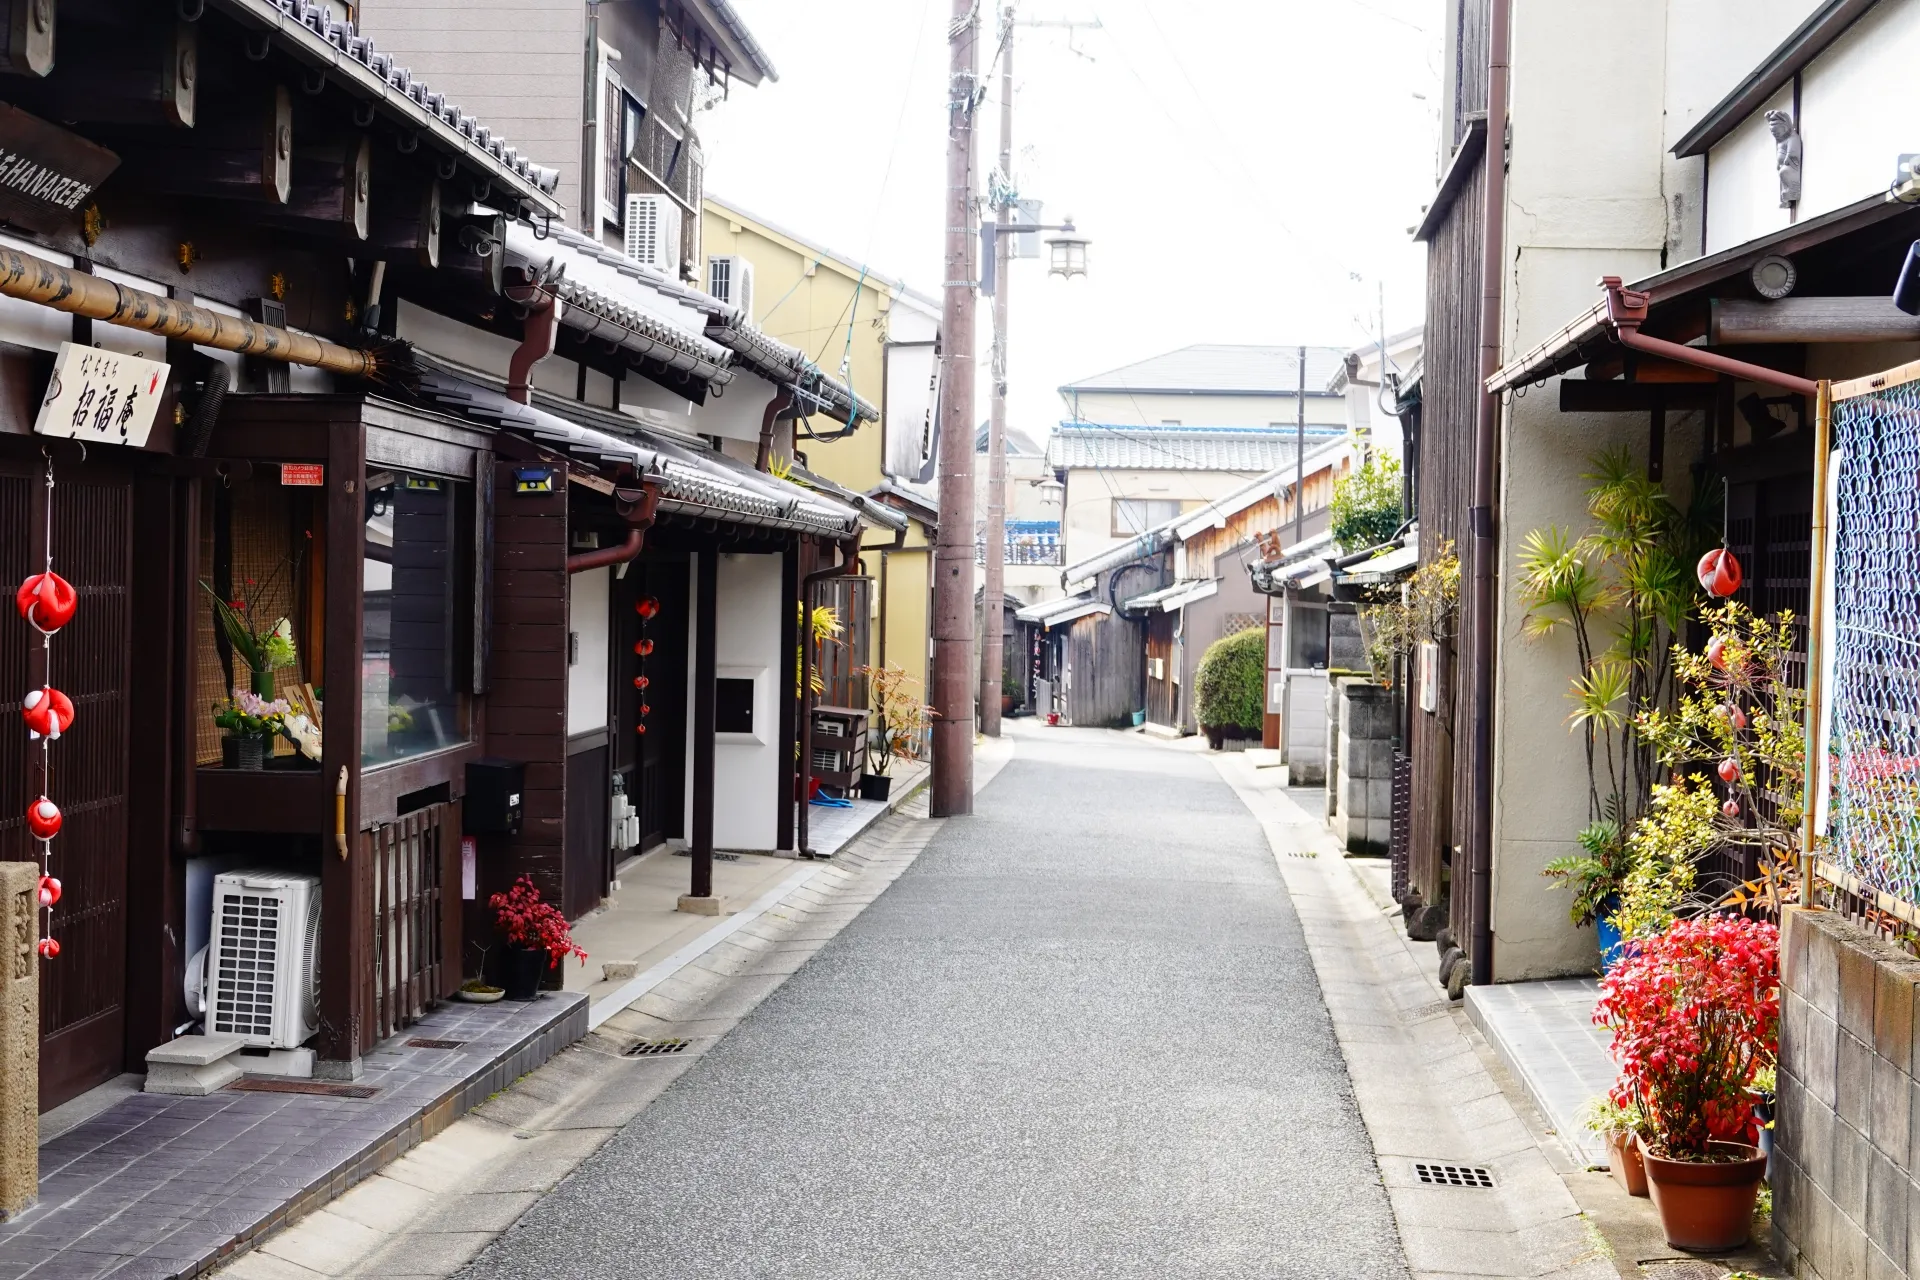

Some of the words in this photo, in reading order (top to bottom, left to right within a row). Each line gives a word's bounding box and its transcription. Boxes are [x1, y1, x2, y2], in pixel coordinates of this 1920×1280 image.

[81, 354, 119, 378] ならまち
[72, 380, 138, 437] 招福庵
